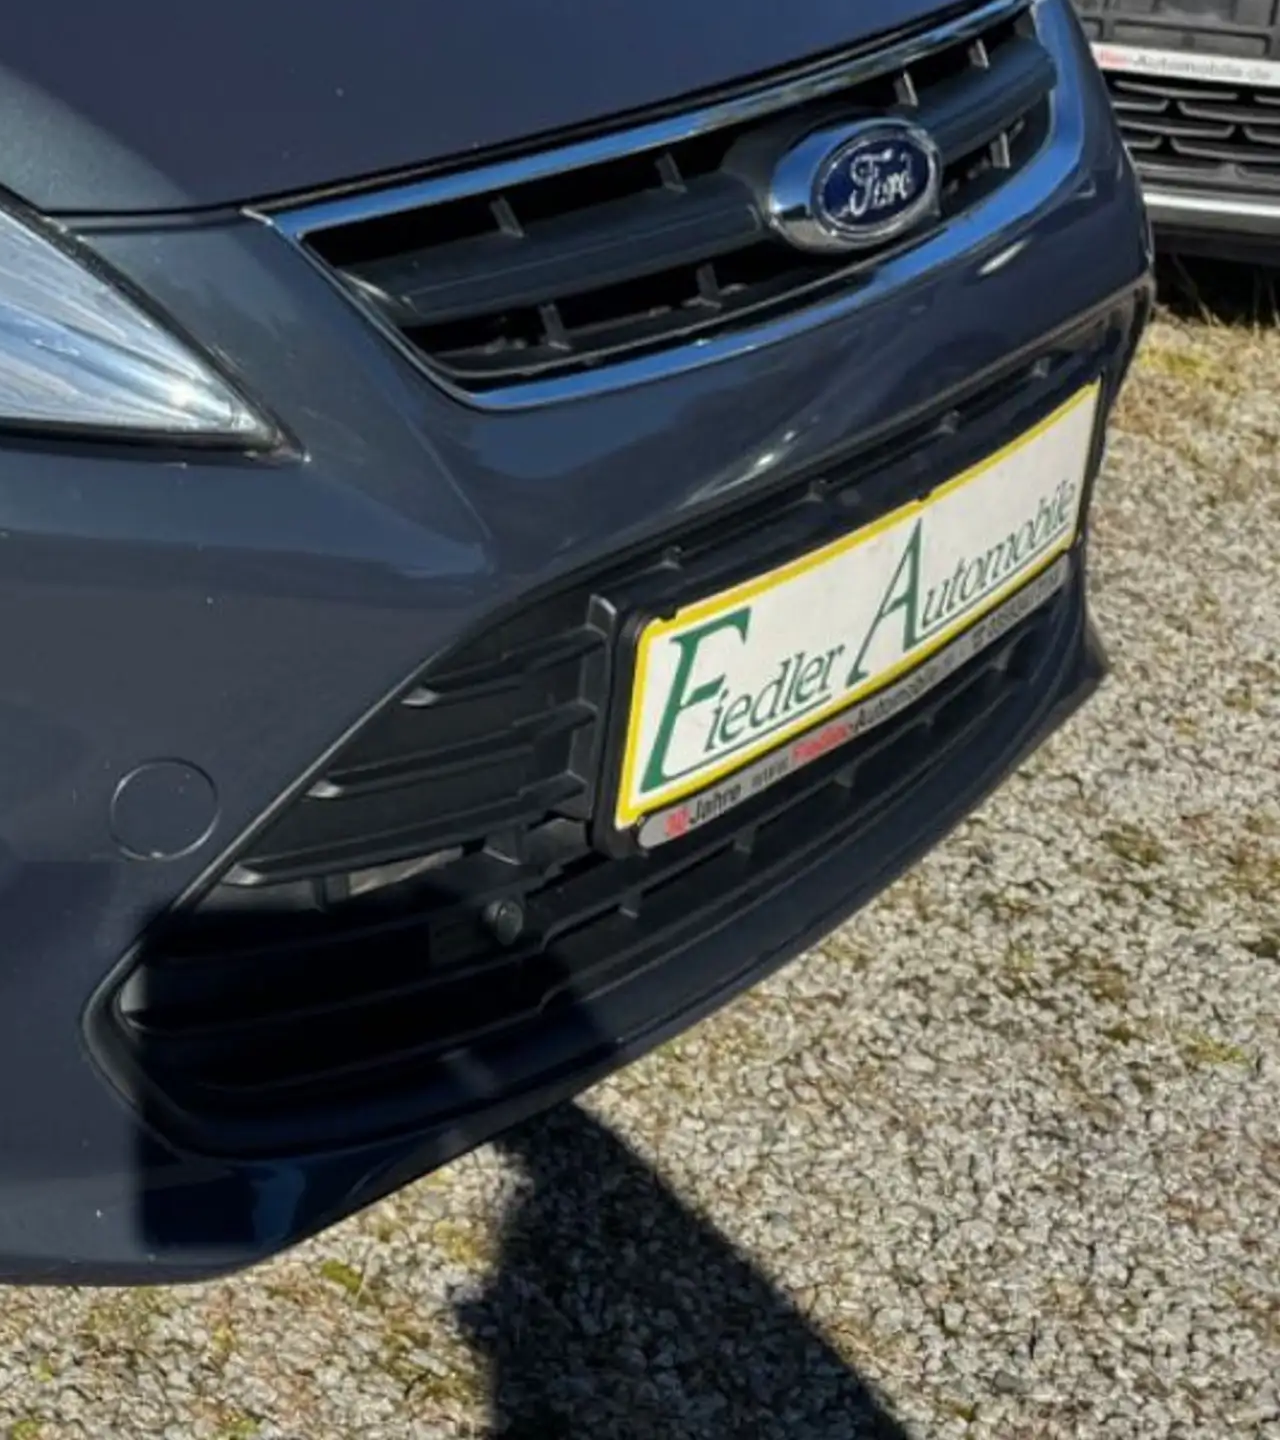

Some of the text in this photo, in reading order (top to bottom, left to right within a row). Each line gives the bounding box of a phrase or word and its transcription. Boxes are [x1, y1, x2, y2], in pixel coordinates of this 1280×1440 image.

[838, 148, 915, 217] Ford
[640, 606, 845, 794] Fiedler
[845, 479, 1076, 688] Automobile
